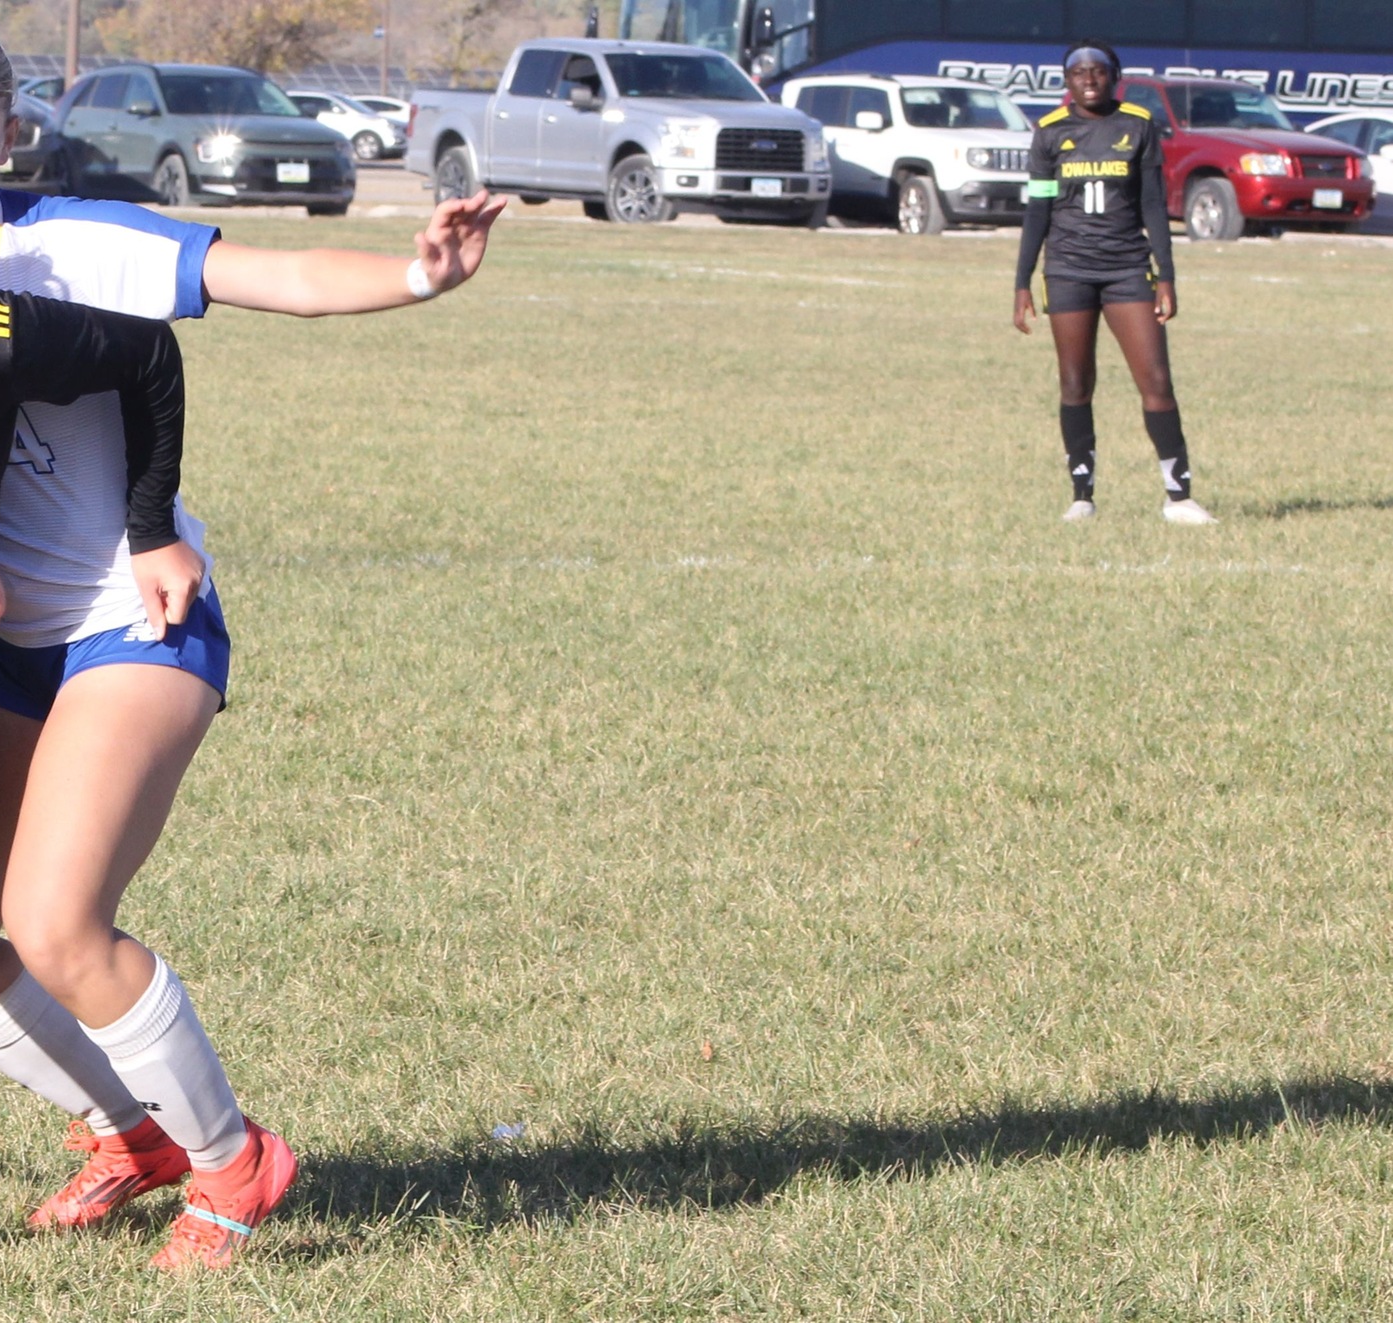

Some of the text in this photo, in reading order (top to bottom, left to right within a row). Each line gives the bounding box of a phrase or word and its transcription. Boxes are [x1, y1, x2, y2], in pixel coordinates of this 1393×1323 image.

[938, 60, 1155, 96] READ
[1061, 161, 1129, 178] IOWA LAKES
[1084, 180, 1105, 214] 11
